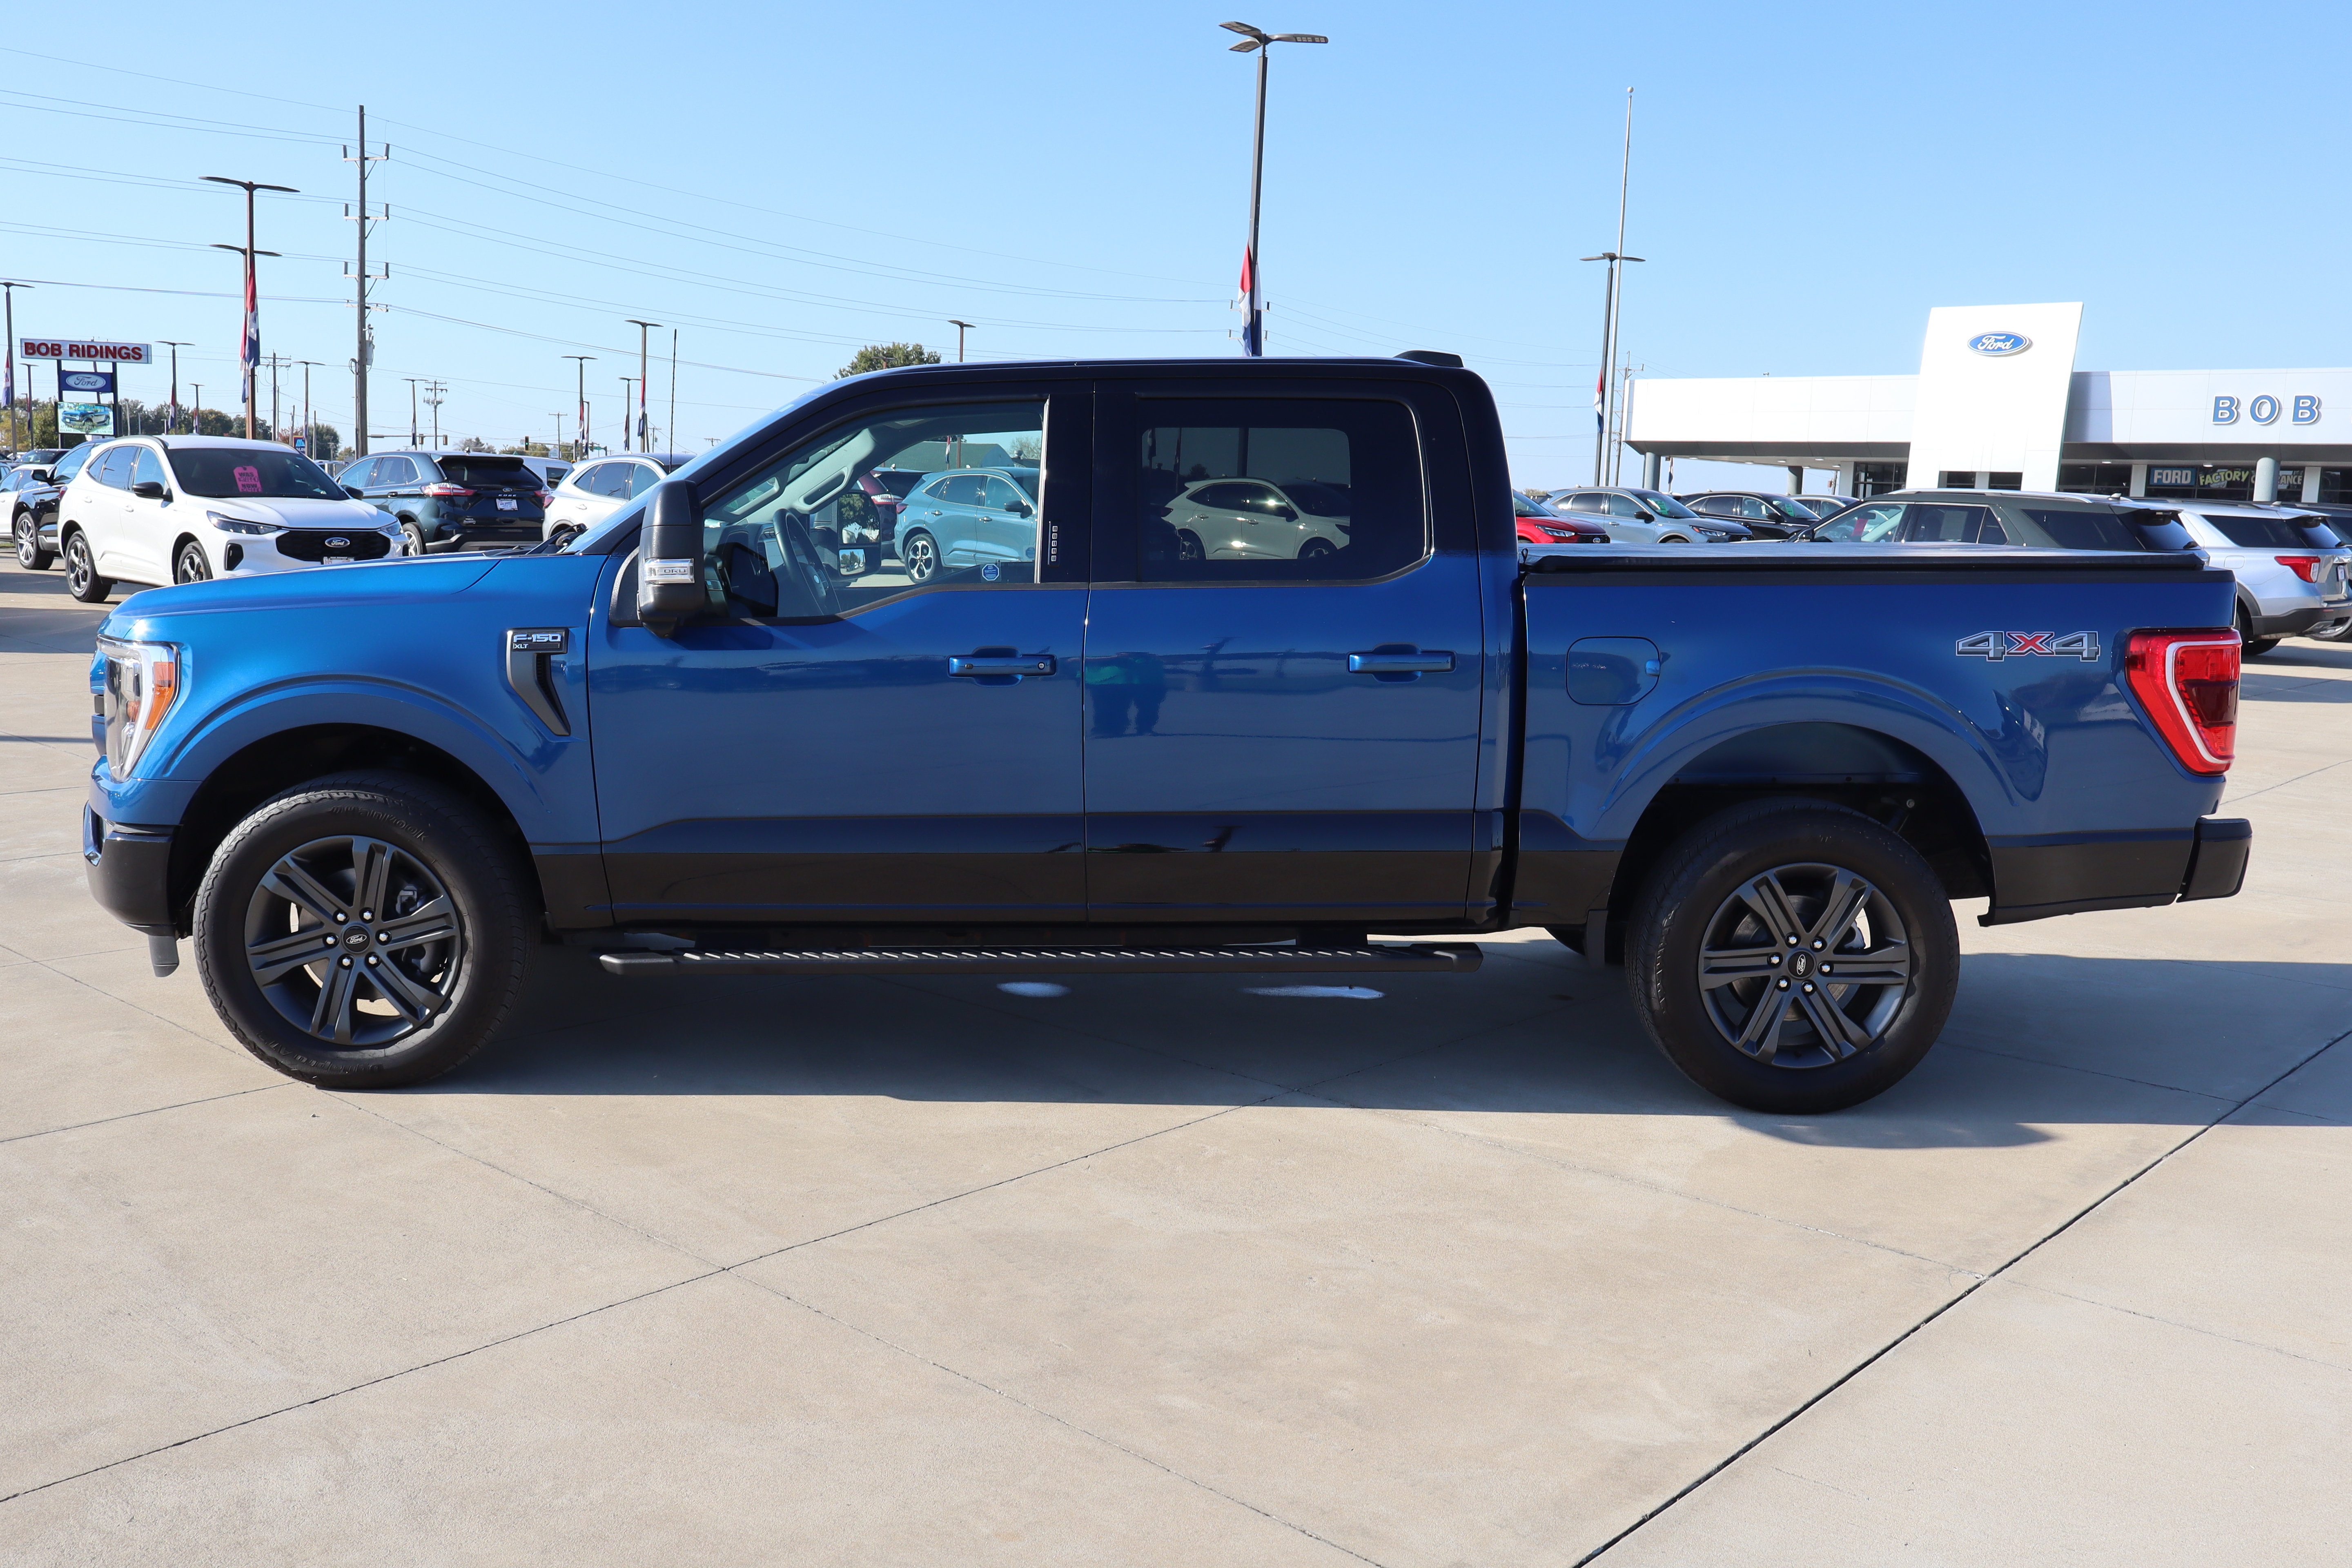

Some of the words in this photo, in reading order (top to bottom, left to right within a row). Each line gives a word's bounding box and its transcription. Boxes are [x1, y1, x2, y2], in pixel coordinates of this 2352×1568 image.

[1977, 335, 2015, 350] Ford
[24, 342, 62, 356] BOB
[69, 344, 143, 360] RIDINGS
[74, 375, 98, 386] Ford
[2211, 394, 2321, 425] BOB
[2153, 469, 2192, 484] FORD
[2199, 470, 2250, 486] FACTORY
[513, 633, 562, 642] F-150
